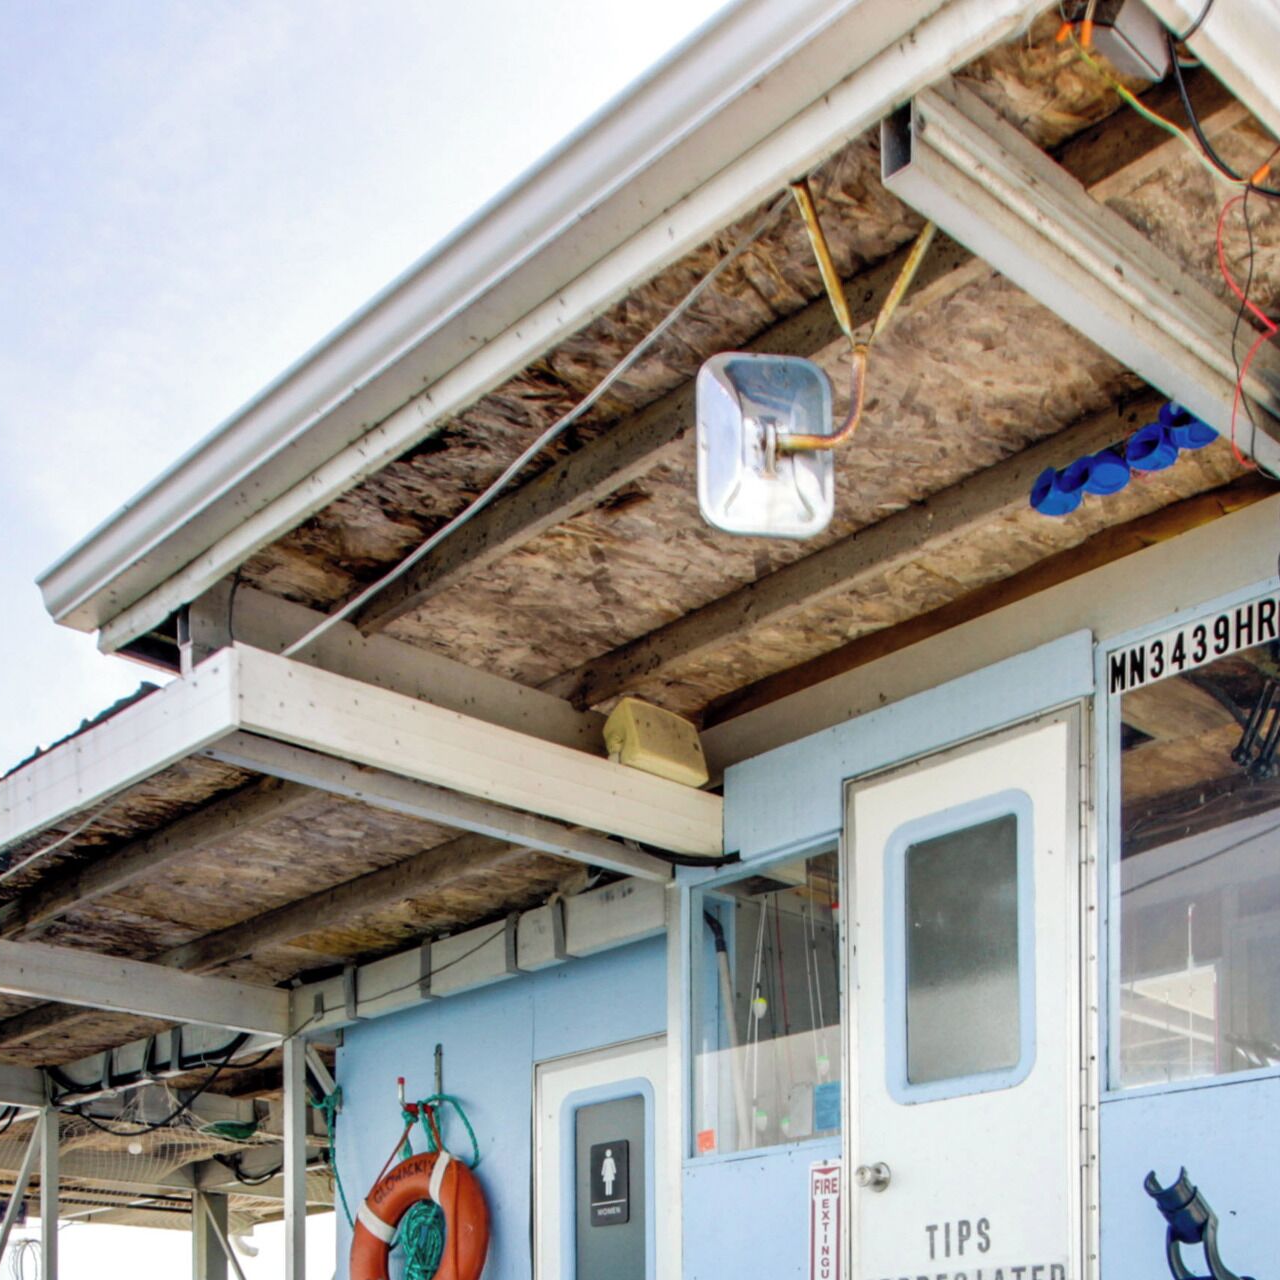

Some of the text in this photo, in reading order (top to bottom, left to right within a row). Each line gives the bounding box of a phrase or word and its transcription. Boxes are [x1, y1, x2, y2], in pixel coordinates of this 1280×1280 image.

[1110, 598, 1277, 694] MN3439HR
[814, 1178, 838, 1195] FIRE
[597, 1206, 621, 1216] WOMEN
[925, 1217, 991, 1260] TIPS
